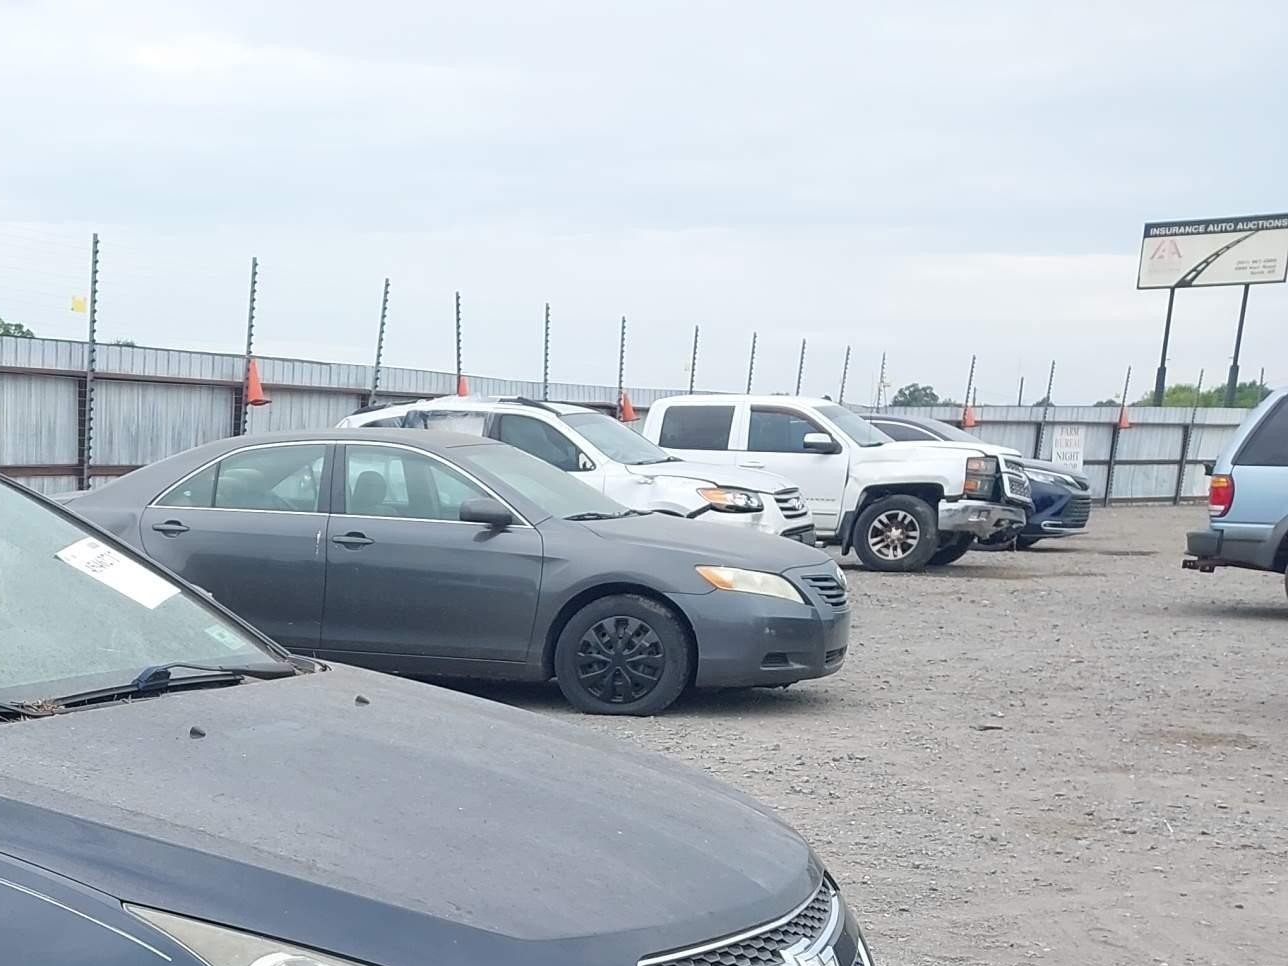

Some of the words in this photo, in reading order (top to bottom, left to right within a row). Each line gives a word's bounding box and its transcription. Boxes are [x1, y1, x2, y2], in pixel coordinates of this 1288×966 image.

[1149, 225, 1206, 236] INSURANCE
[1206, 222, 1235, 233] AUTO
[1237, 218, 1288, 231] AUCTIONS
[1056, 450, 1080, 461] NIGHT
